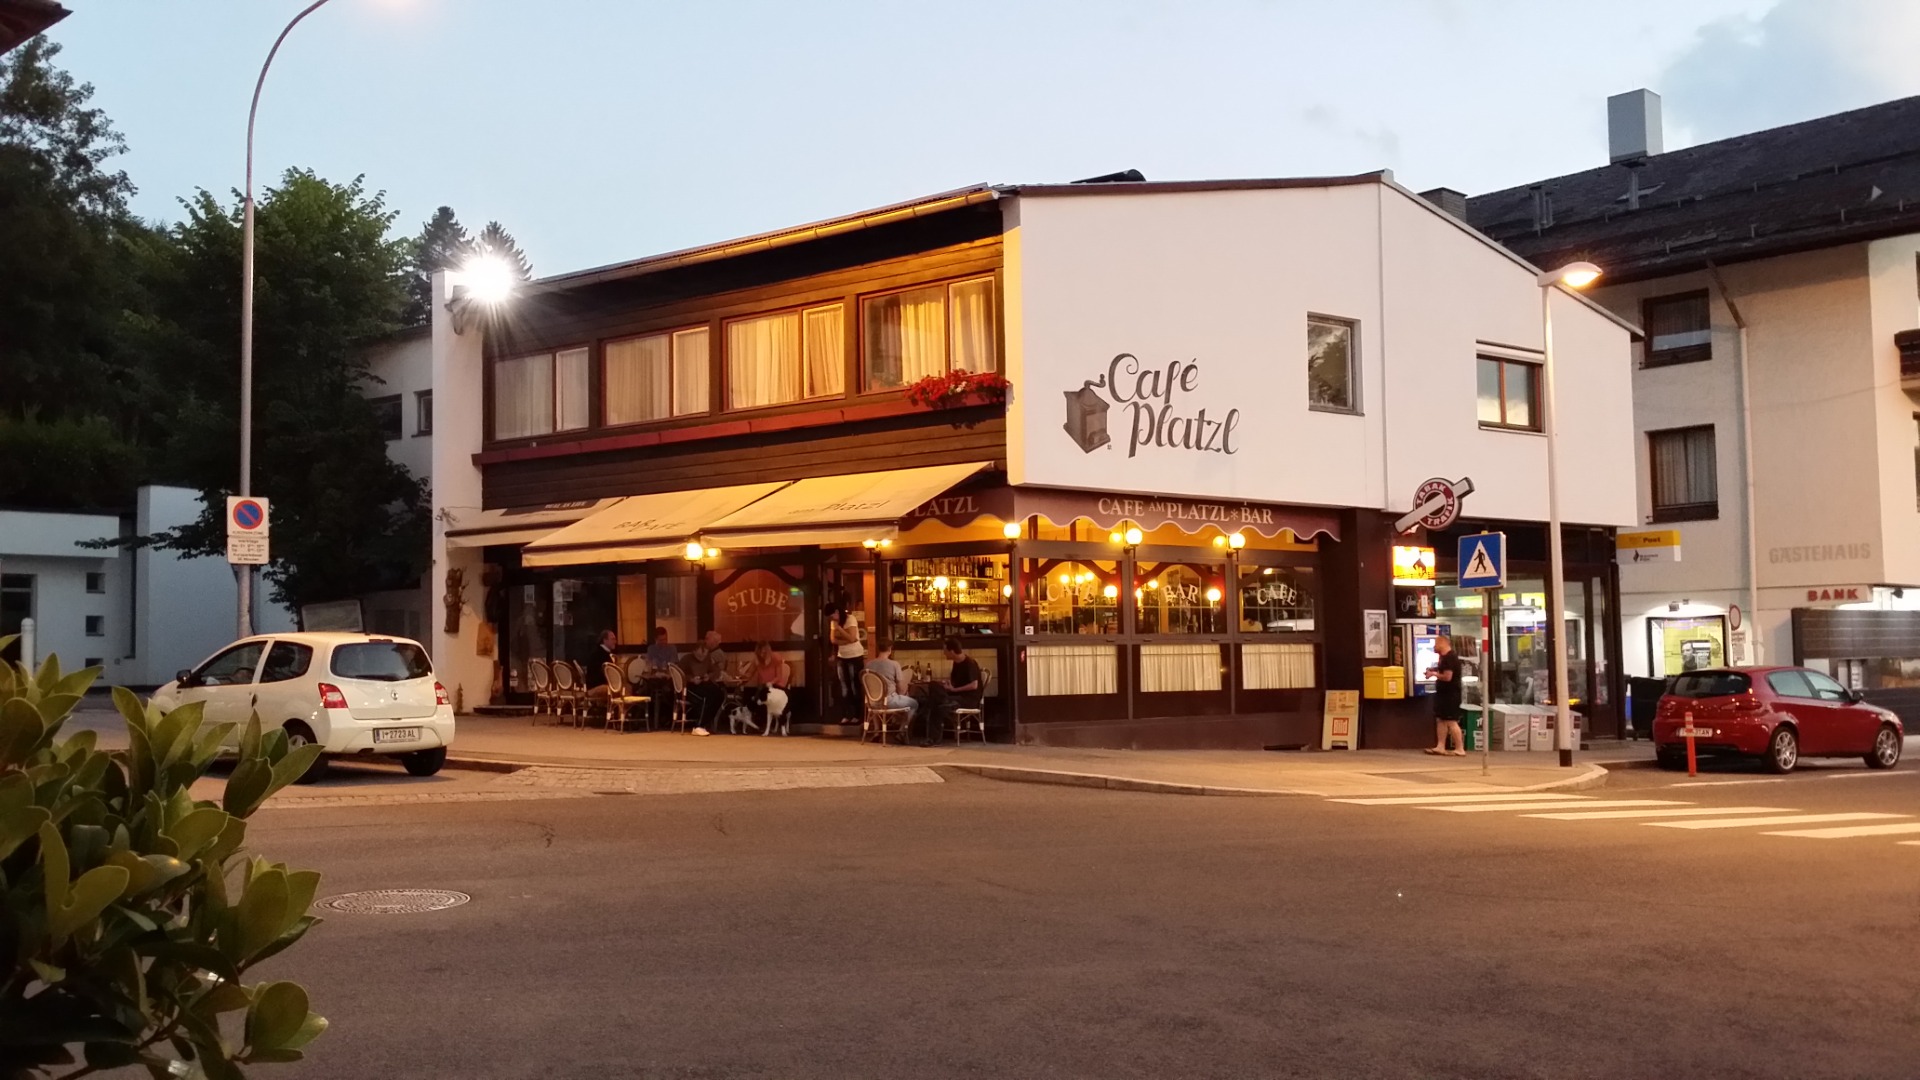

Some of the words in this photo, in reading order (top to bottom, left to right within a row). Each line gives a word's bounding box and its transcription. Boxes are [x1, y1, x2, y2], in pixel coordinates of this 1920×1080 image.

[1108, 353, 1198, 404] Café
[1123, 401, 1239, 458] Platzl
[1416, 483, 1446, 503] TABAK
[904, 496, 980, 517] LATZL
[1098, 498, 1145, 517] CAFE
[1149, 503, 1165, 512] AM
[1167, 502, 1230, 522] PLATZL
[1241, 507, 1274, 525] BAR
[1427, 497, 1454, 525] TRAFIK
[727, 588, 789, 612] STUBE
[1161, 583, 1199, 603] BAR
[1257, 583, 1297, 606] CAFE
[1807, 588, 1859, 602] BANK
